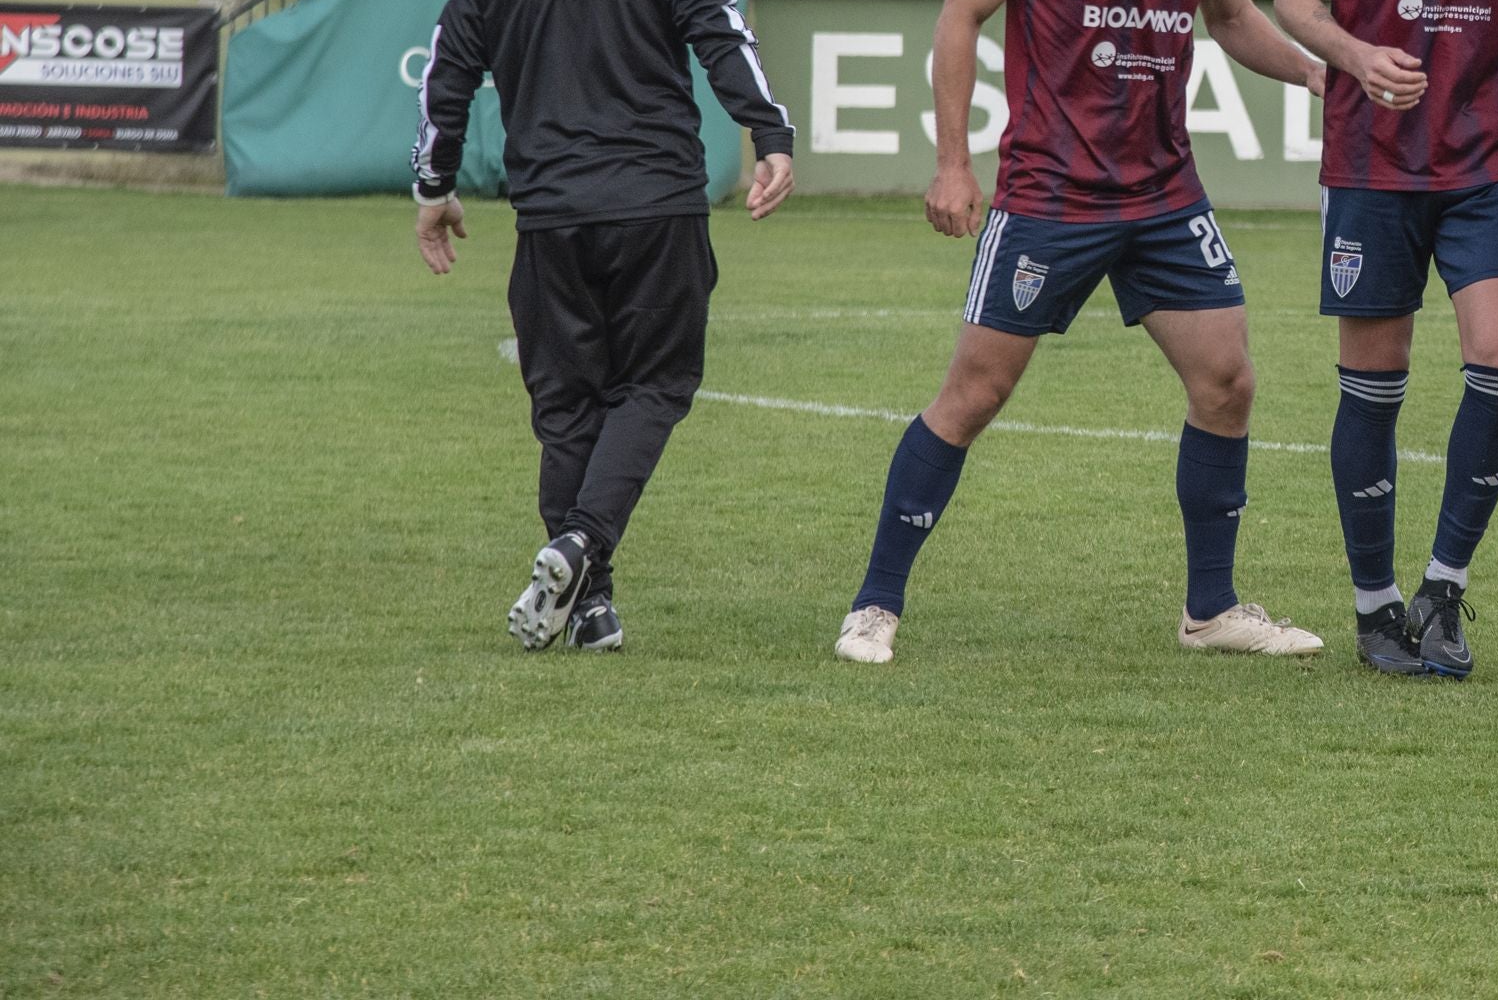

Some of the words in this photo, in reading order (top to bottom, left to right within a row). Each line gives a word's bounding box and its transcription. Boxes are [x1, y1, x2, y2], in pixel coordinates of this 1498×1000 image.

[1083, 4, 1194, 34] BIOAMMO
[41, 63, 145, 82] SOLUCIONES
[151, 66, 179, 83] SLU
[75, 105, 149, 120] INDUSTRIA
